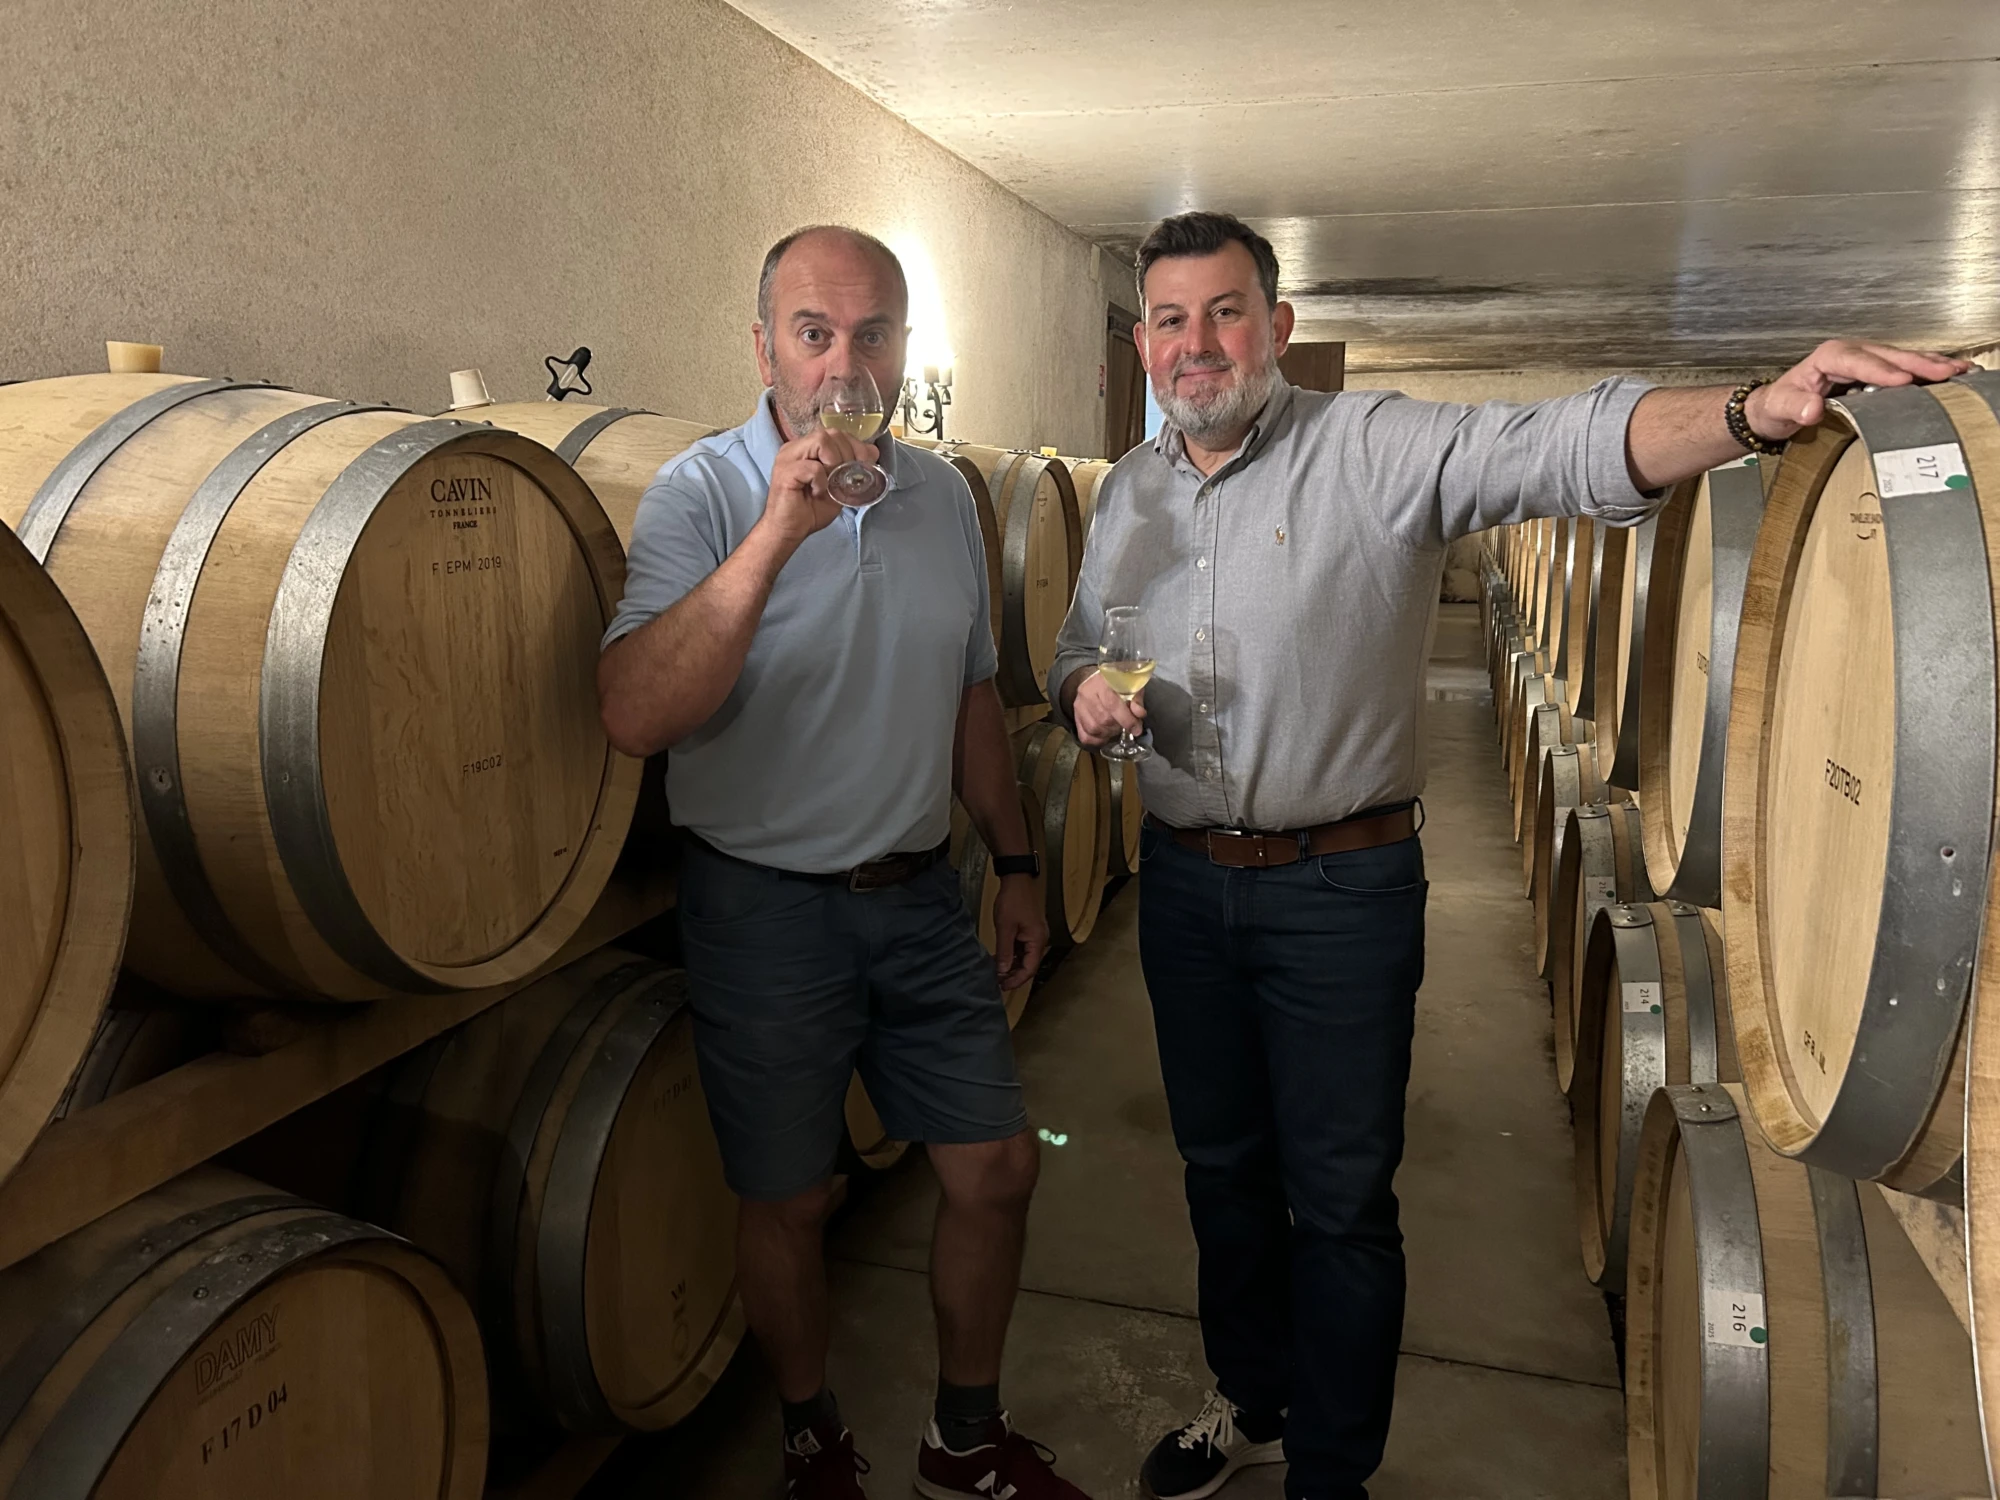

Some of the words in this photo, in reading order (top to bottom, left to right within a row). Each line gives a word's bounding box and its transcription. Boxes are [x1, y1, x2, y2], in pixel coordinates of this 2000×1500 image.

[1916, 455, 1940, 479] 217
[430, 477, 492, 503] CAVIN
[453, 520, 478, 530] FRANCE
[432, 562, 439, 576] F
[446, 560, 472, 574] EPM
[478, 556, 502, 571] 2019
[1825, 758, 1861, 806] F20TB02
[1640, 988, 1650, 1005] 214
[1732, 1303, 1747, 1332] 216
[195, 1302, 281, 1395] DAMY
[202, 1437, 214, 1465] F
[223, 1416, 241, 1449] 17
[248, 1403, 262, 1429] D
[268, 1381, 288, 1413] 04
